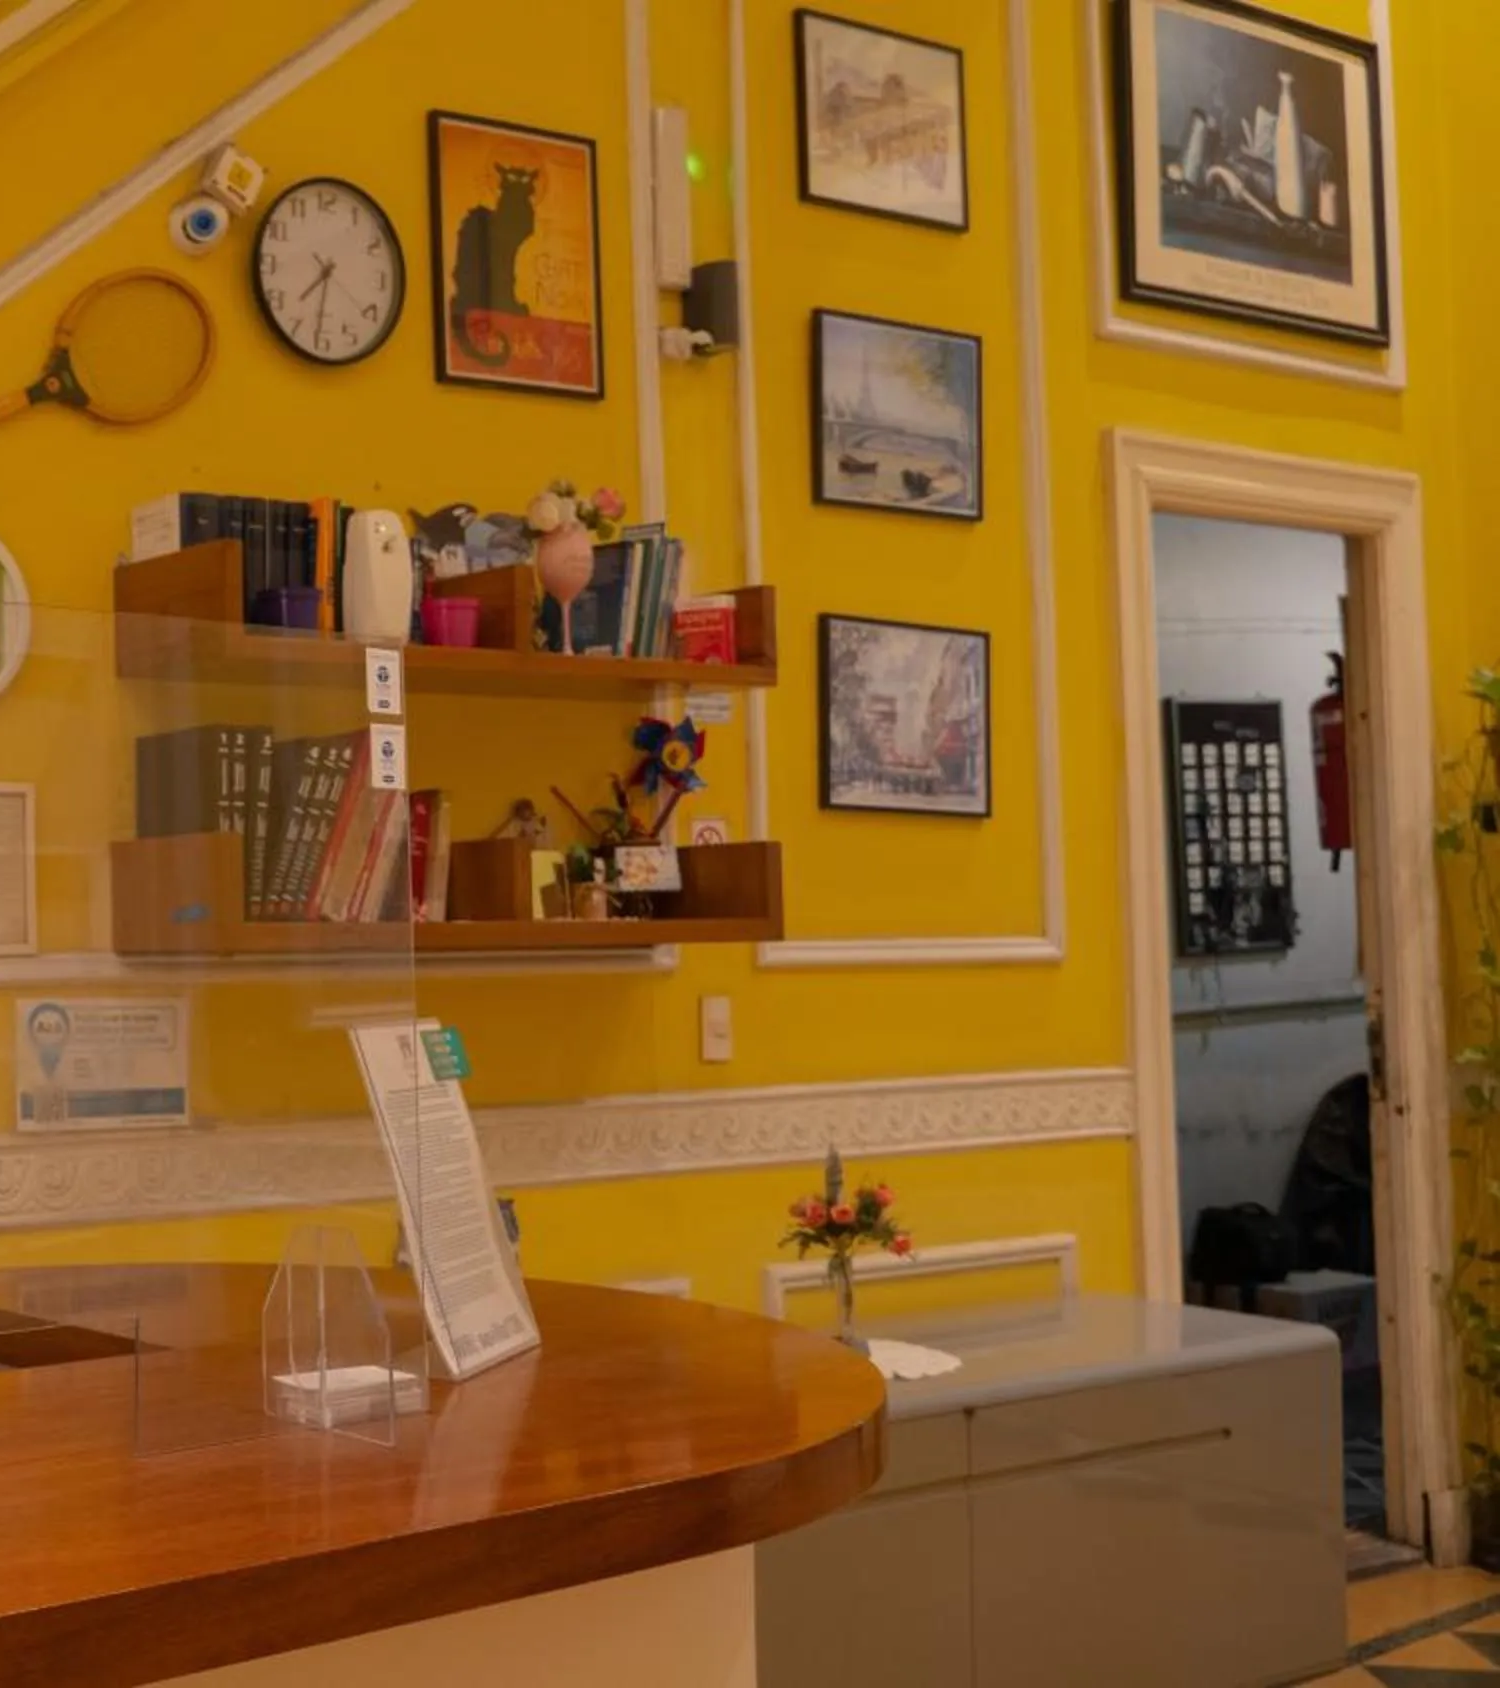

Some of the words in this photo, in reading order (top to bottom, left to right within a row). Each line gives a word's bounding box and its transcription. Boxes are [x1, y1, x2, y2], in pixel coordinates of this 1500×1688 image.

[291, 194, 306, 219] 11
[318, 189, 337, 214] 12
[352, 205, 359, 227] 1
[268, 220, 288, 241] 10
[367, 237, 381, 256] 2
[263, 252, 276, 275] 9
[375, 270, 386, 292] 3
[267, 288, 284, 311] 8
[361, 303, 377, 323] 4
[289, 316, 303, 337] 7
[341, 321, 358, 346] 5
[314, 329, 330, 352] 6
